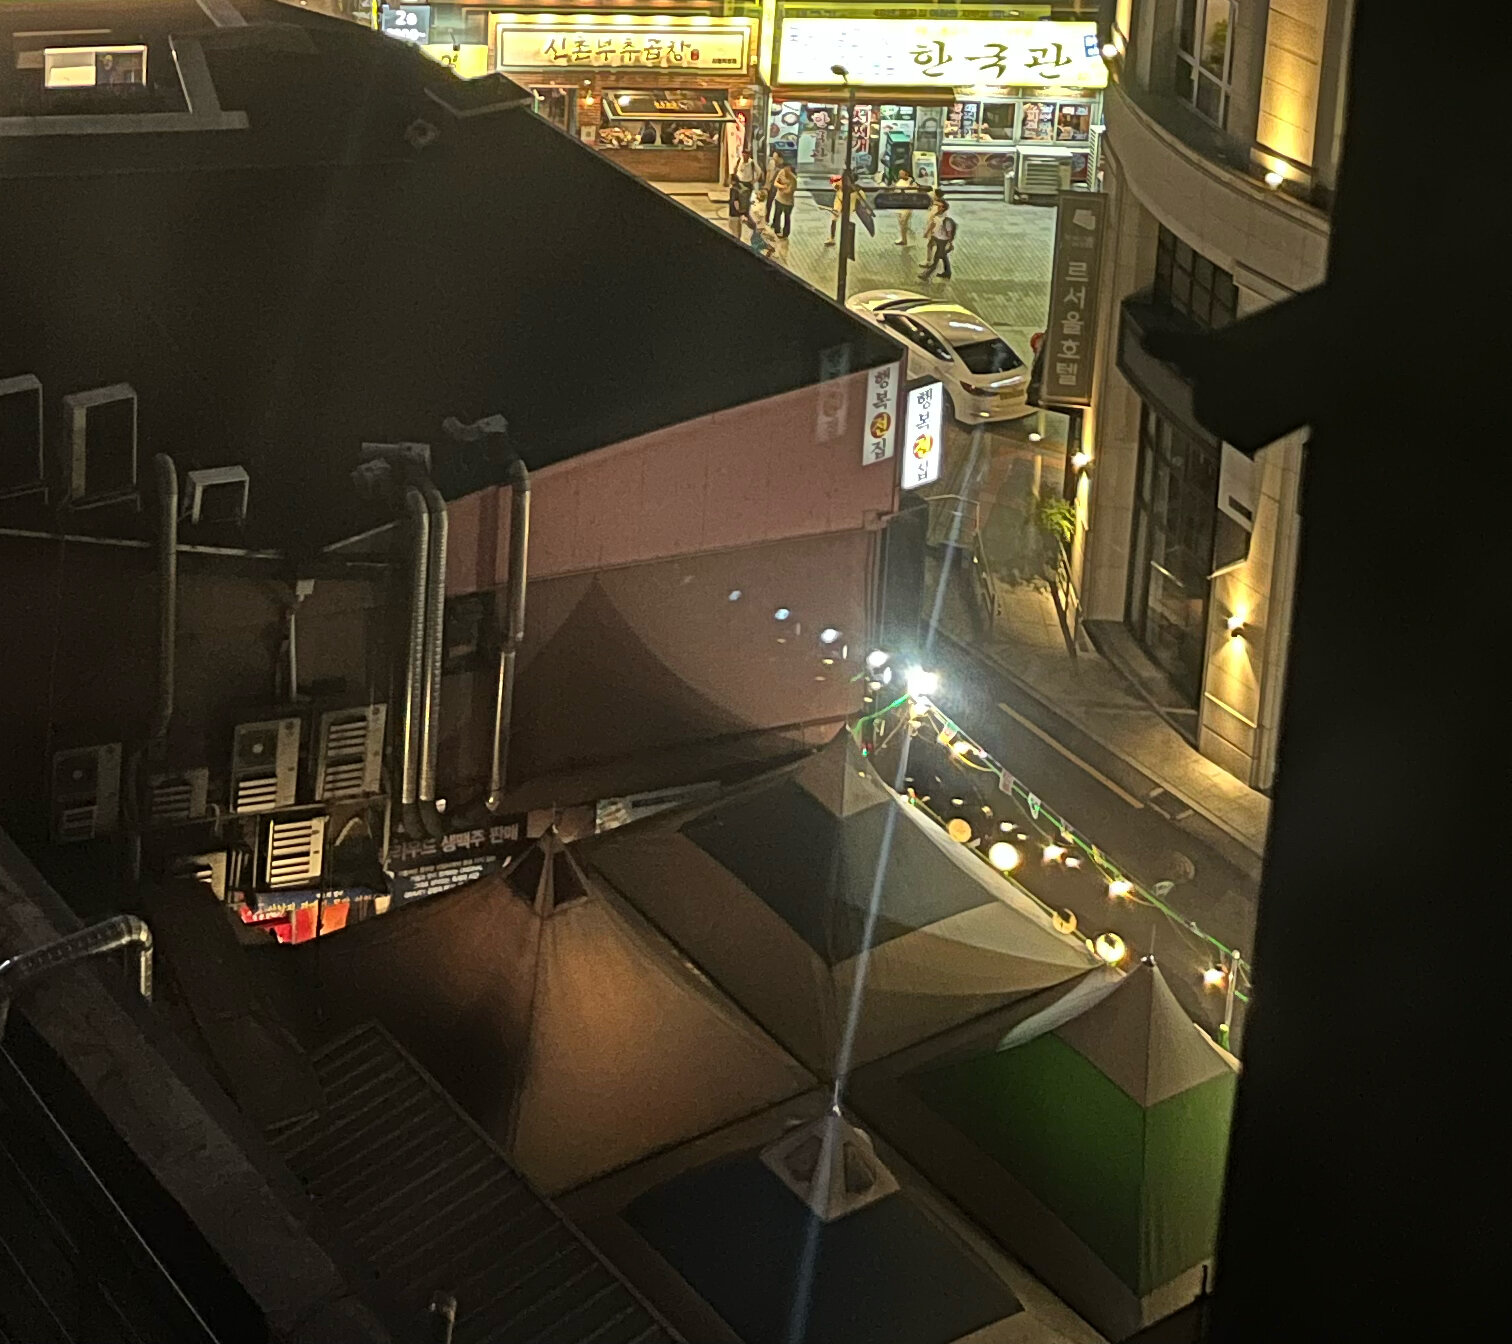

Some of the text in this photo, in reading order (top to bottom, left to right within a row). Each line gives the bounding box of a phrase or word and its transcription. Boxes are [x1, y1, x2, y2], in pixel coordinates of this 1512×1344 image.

[544, 35, 692, 63] 신촌부추곱창
[909, 40, 1073, 79] 한국관
[1055, 261, 1090, 386] 르서울호텔
[389, 823, 519, 863] 라우드 생맥주 판매
